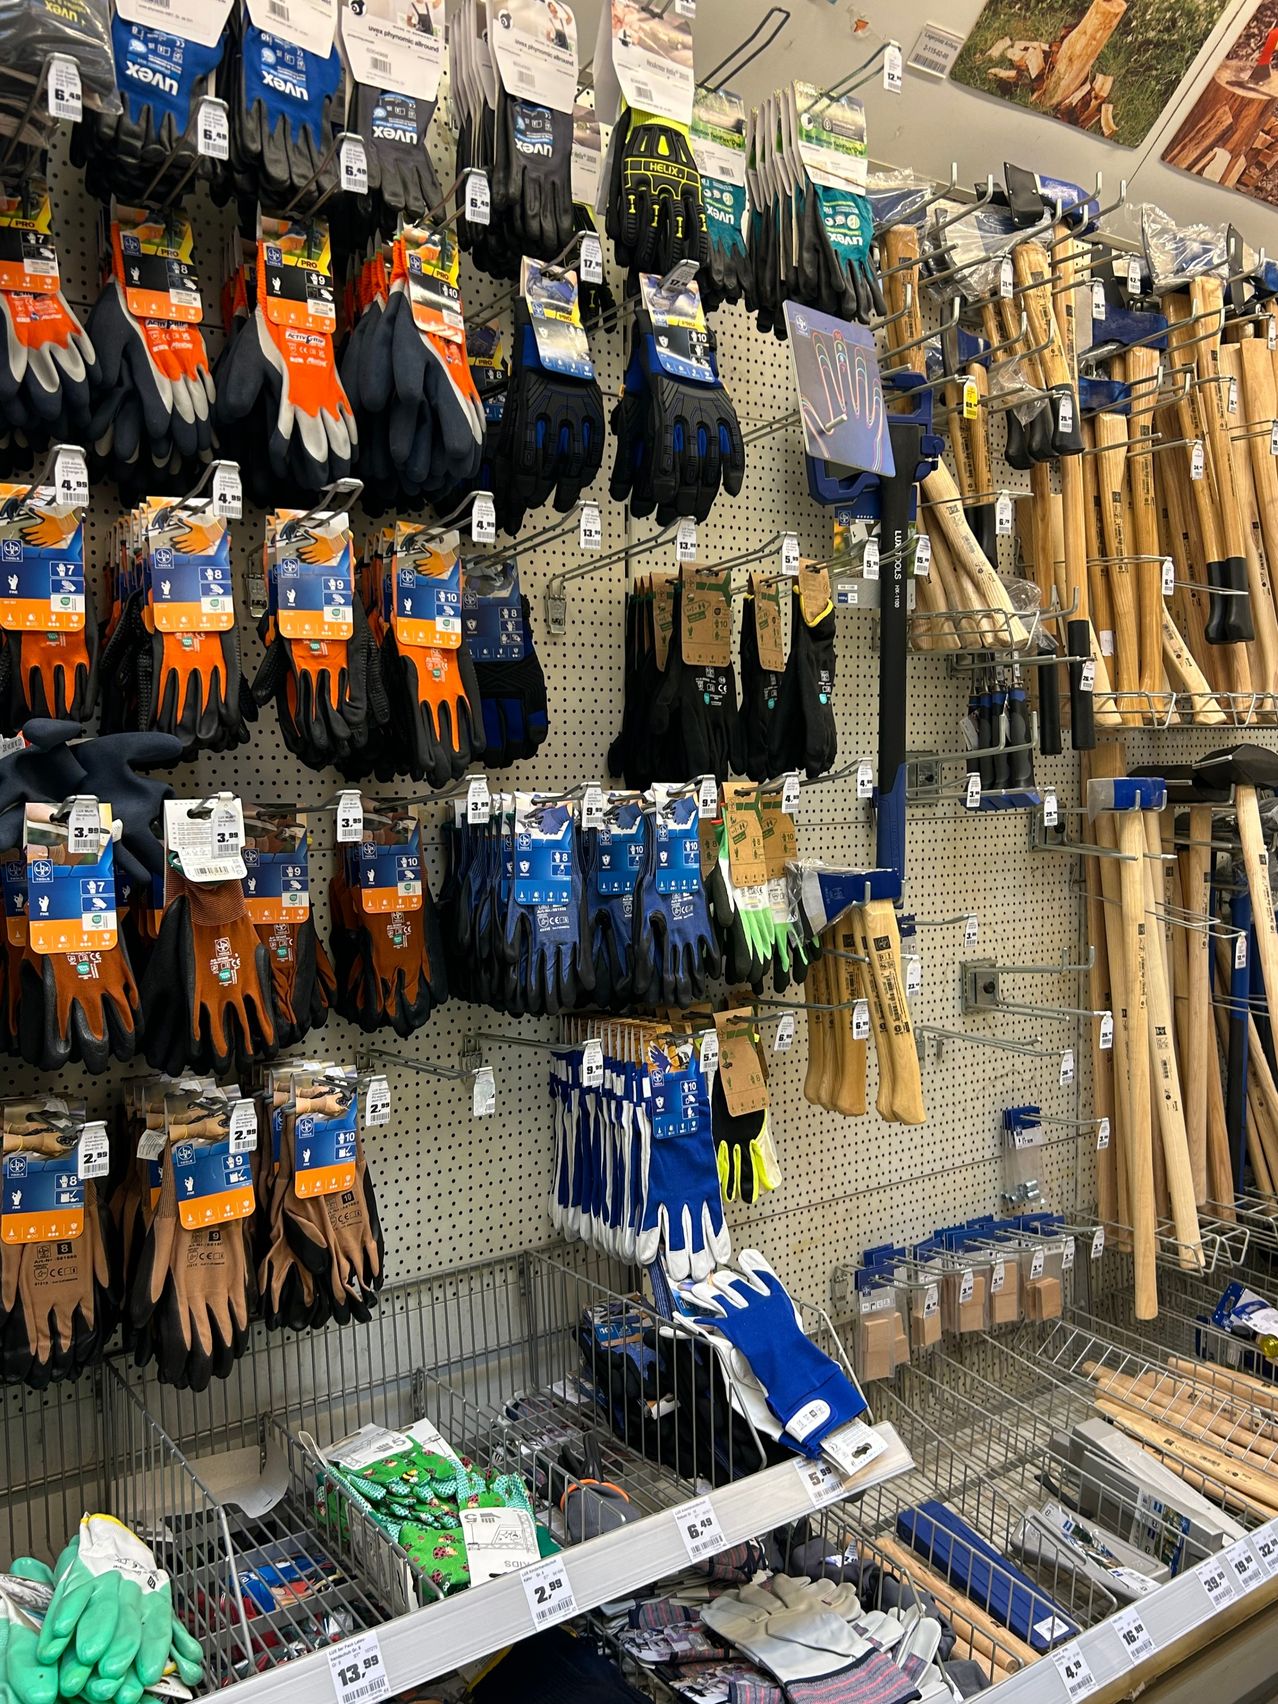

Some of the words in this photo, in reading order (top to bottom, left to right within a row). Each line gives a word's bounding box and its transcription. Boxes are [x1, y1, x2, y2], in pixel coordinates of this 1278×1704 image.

[45, 2, 78, 21] uvex
[368, 25, 384, 36] uvex
[413, 37, 440, 53] allround
[125, 62, 180, 96] uvex
[262, 71, 309, 101] uvex
[55, 88, 81, 102] 6,49
[203, 128, 227, 142] 6,49
[372, 125, 418, 145] uvex
[514, 138, 553, 158] uvex
[345, 165, 367, 178] 6,49
[470, 197, 489, 209] 6,49
[705, 203, 735, 225] uvex
[15, 220, 35, 229] PRO
[37, 235, 44, 244] 7
[827, 232, 863, 247] uvex
[160, 248, 179, 258] PRO
[180, 264, 188, 274] 8
[301, 260, 318, 269] PRO
[436, 271, 450, 281] PRO
[318, 277, 325, 286] 9
[697, 333, 707, 343] 10
[496, 371, 503, 379] 8
[61, 480, 88, 491] 4,99
[218, 493, 241, 504] 4,99
[476, 520, 495, 531] 4,99
[66, 565, 74, 575] 7
[214, 570, 223, 579] 8
[336, 580, 344, 589] 9
[446, 592, 457, 602] 10
[511, 609, 518, 617] 8
[719, 620, 728, 628] 10
[471, 801, 489, 811] 3,99
[341, 818, 362, 827] 3,99
[74, 827, 99, 838] 3,99
[217, 832, 239, 843] 3,99
[634, 845, 644, 854] 10
[690, 842, 698, 850] 10
[408, 857, 418, 866] 10
[562, 853, 568, 861] 8
[294, 867, 301, 876] 9
[97, 882, 105, 892] 7
[688, 1082, 697, 1091] 10
[370, 1102, 390, 1114] 2,99
[234, 1129, 257, 1141] 2,99
[344, 1132, 356, 1142] 10
[83, 1151, 108, 1164] 2,99
[235, 1156, 243, 1165] 9
[69, 1176, 78, 1186] 8
[343, 1193, 352, 1202] 10
[211, 1232, 220, 1240] 9
[60, 1243, 69, 1253] 8
[807, 1466, 832, 1487] 5,99
[686, 1517, 713, 1540] 6,49
[534, 1578, 563, 1605] 2,99
[337, 1654, 380, 1687] 13,99
